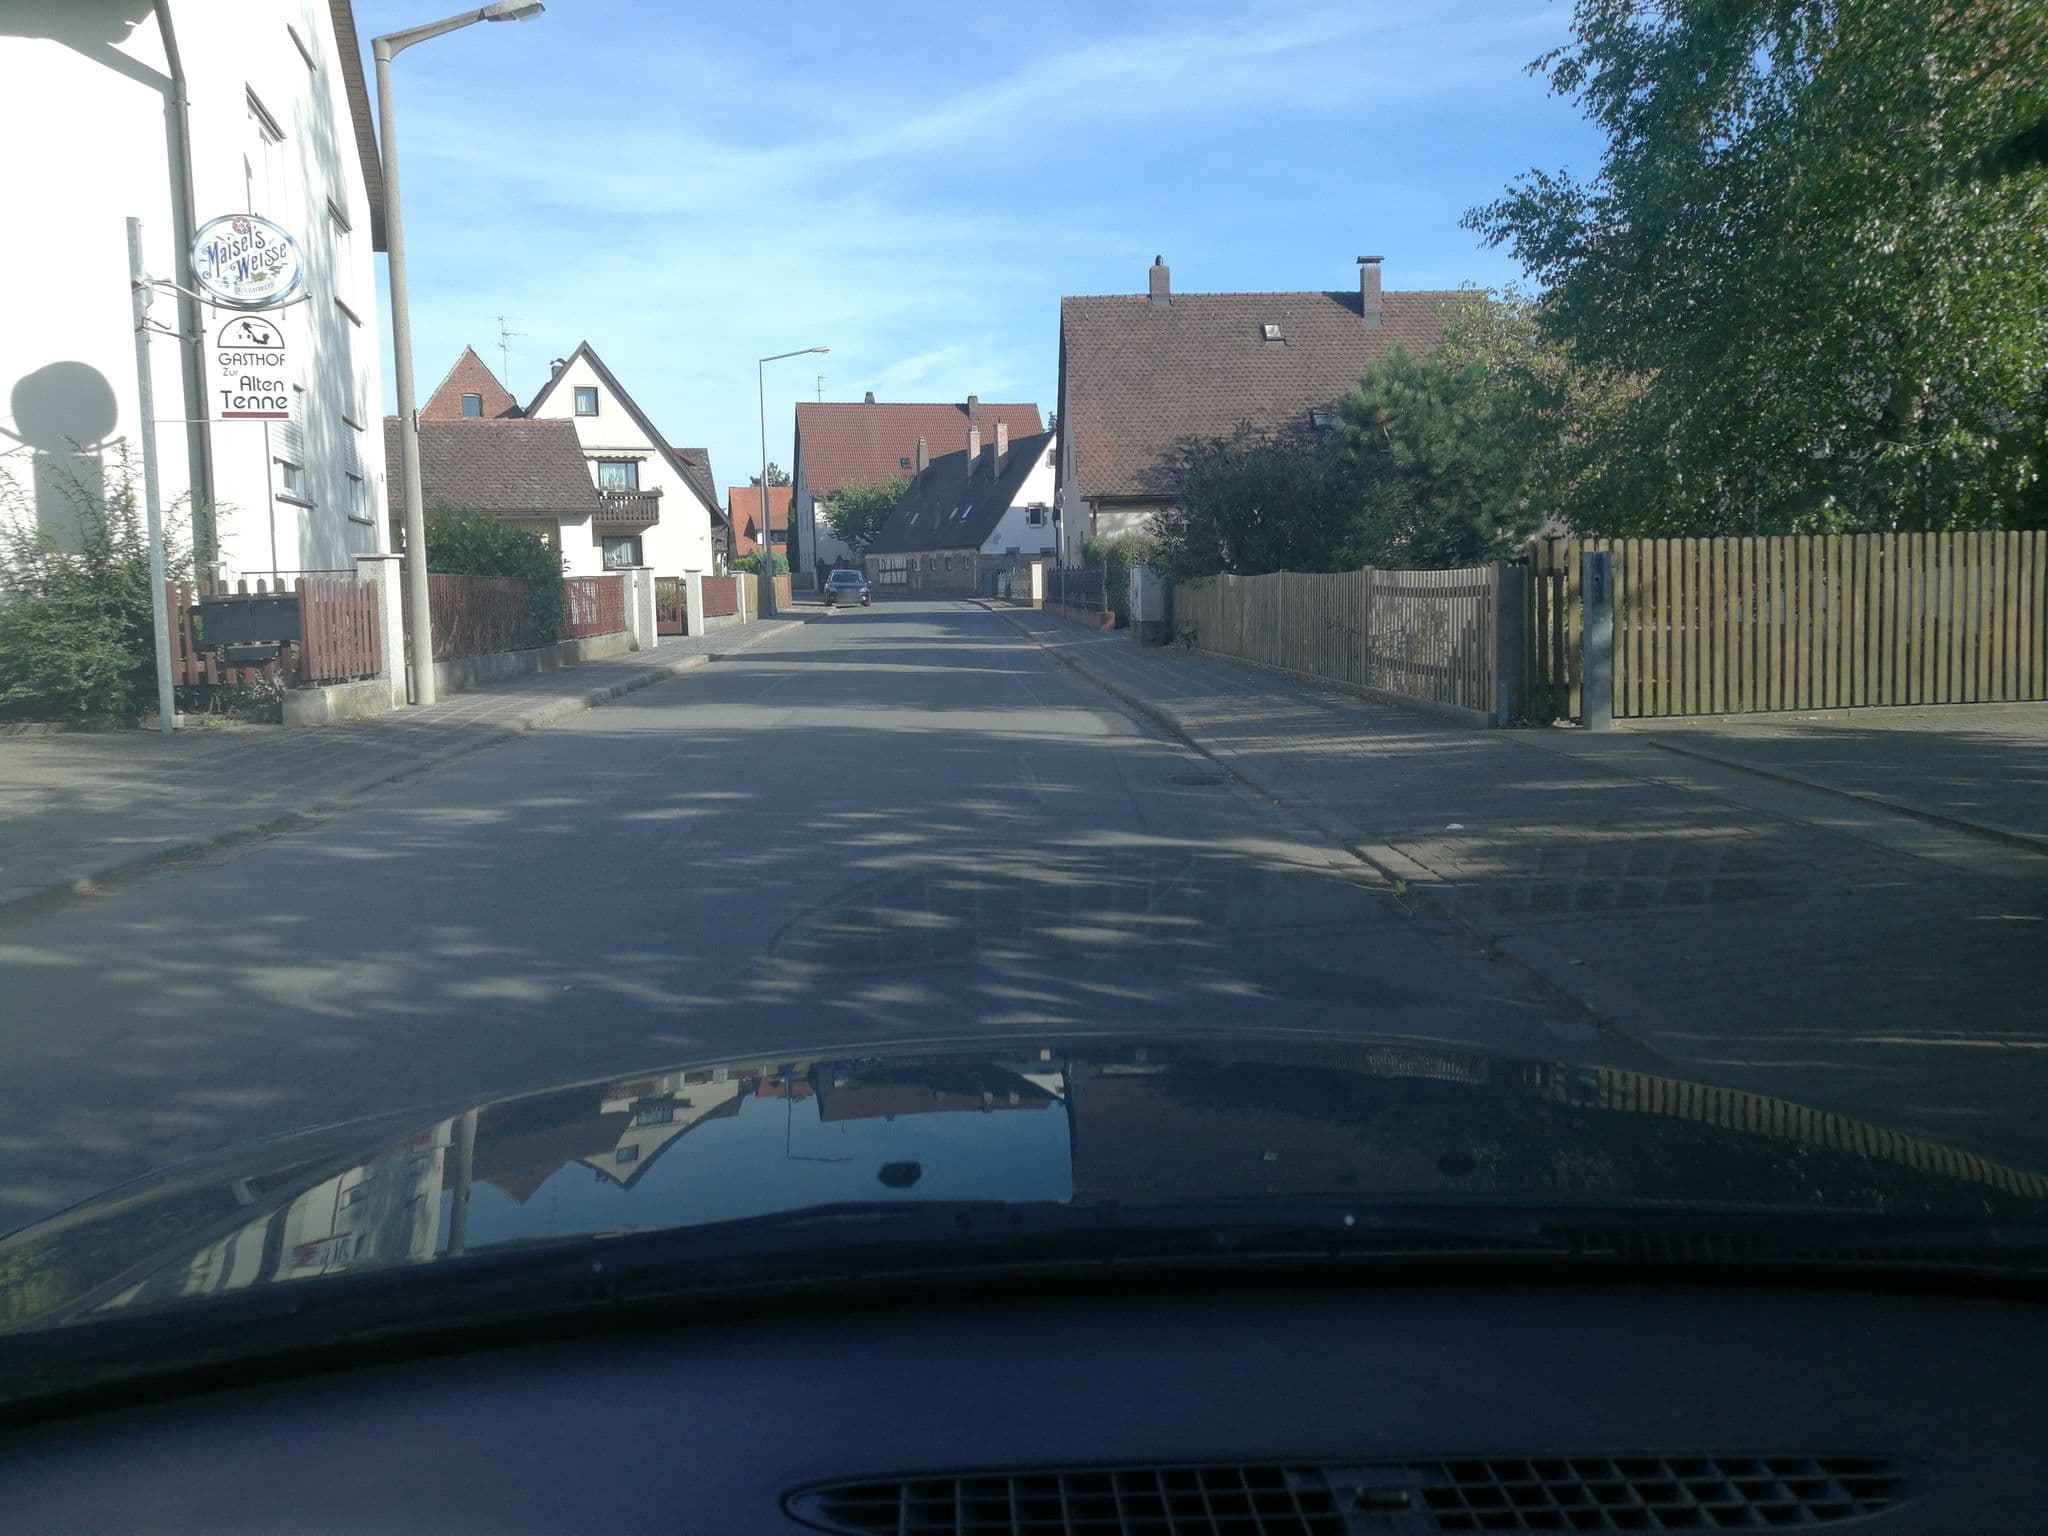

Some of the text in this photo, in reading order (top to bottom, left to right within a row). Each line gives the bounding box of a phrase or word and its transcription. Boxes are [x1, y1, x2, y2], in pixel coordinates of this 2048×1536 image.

[202, 226, 265, 280] Maisel's
[230, 243, 287, 281] Weisse
[218, 353, 286, 366] GASTHOF
[240, 375, 285, 392] Alten
[220, 390, 288, 410] Tenne
